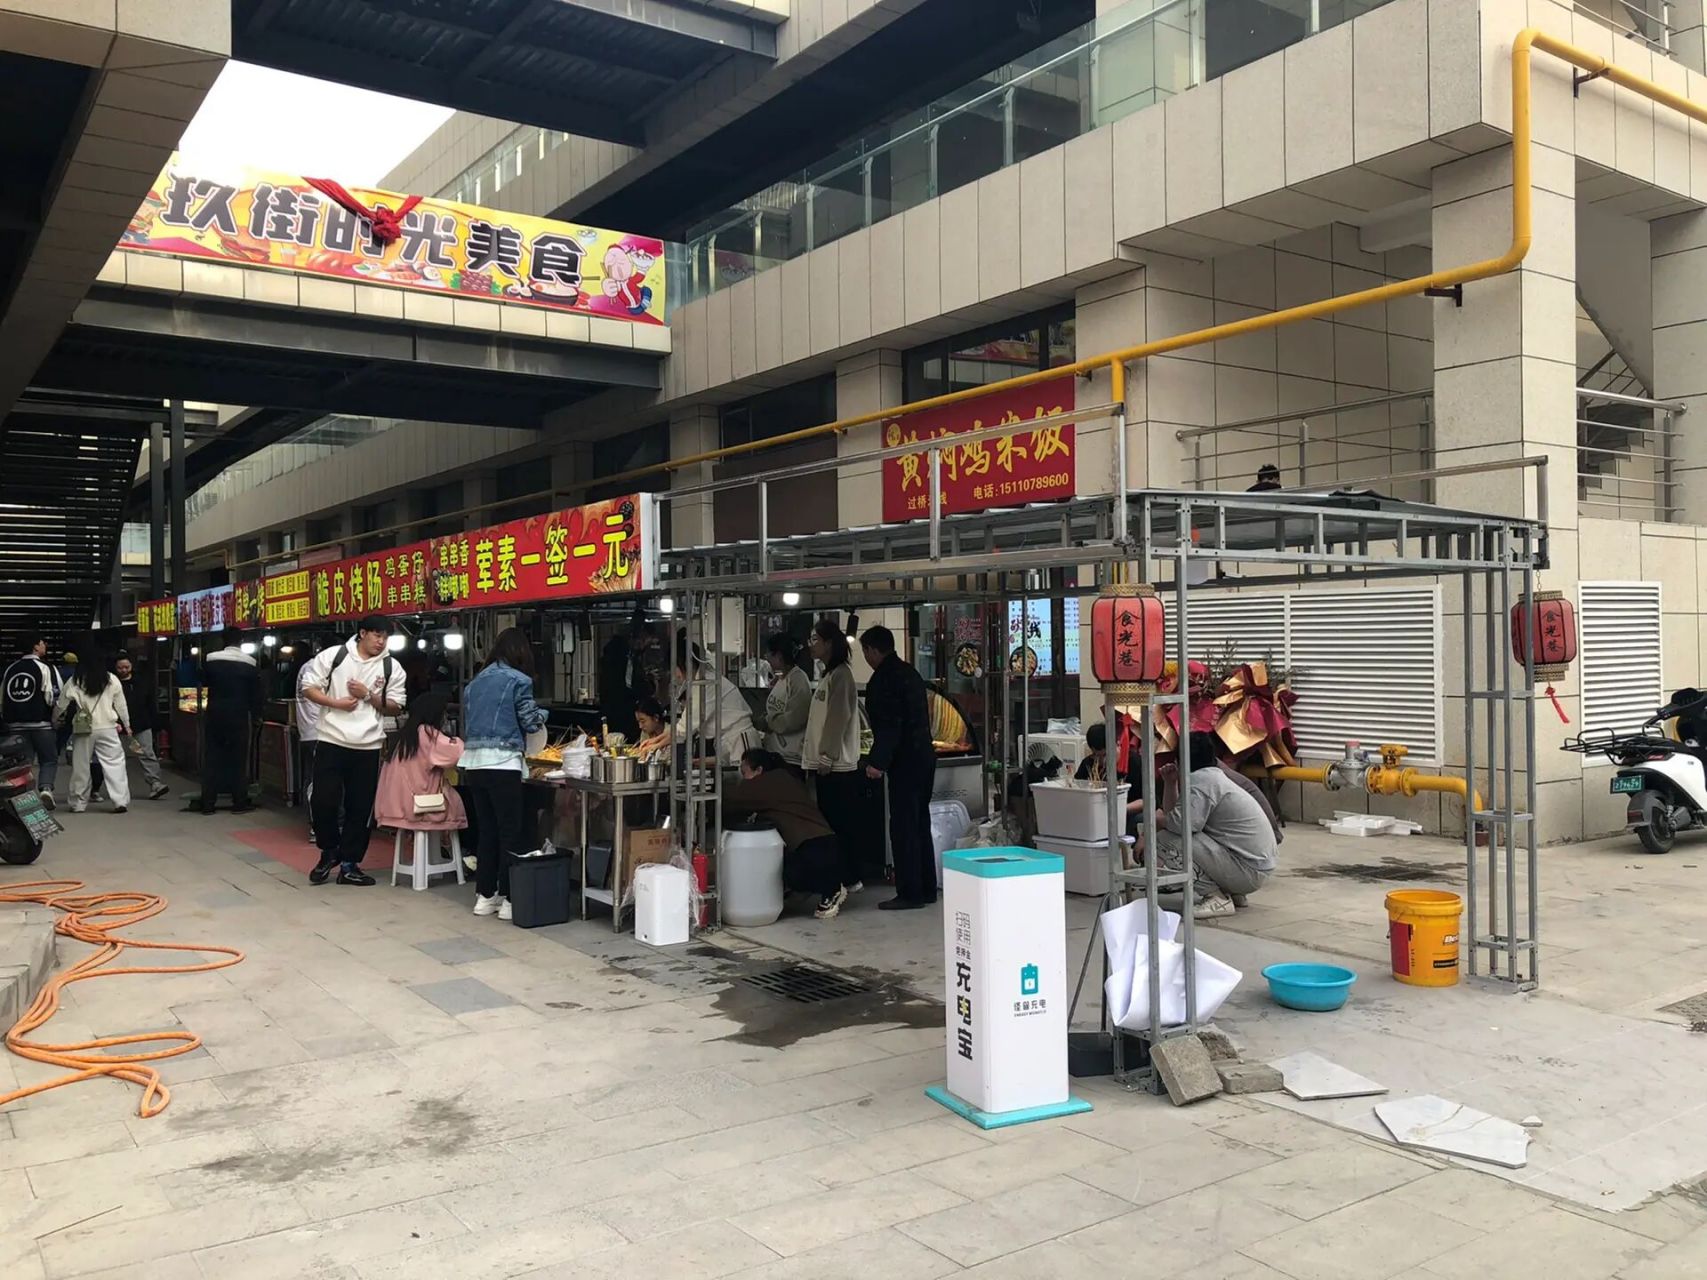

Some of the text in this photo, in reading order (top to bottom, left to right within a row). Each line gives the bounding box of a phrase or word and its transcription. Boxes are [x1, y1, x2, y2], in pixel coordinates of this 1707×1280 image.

[907, 492, 948, 511] 过桥线
[385, 551, 424, 579] 鸡蛋仔
[439, 539, 470, 569] 串串香
[475, 513, 630, 593] 荤素一签一元
[317, 561, 382, 616] 脆皮烤肠
[956, 961, 973, 1061] 充电宝
